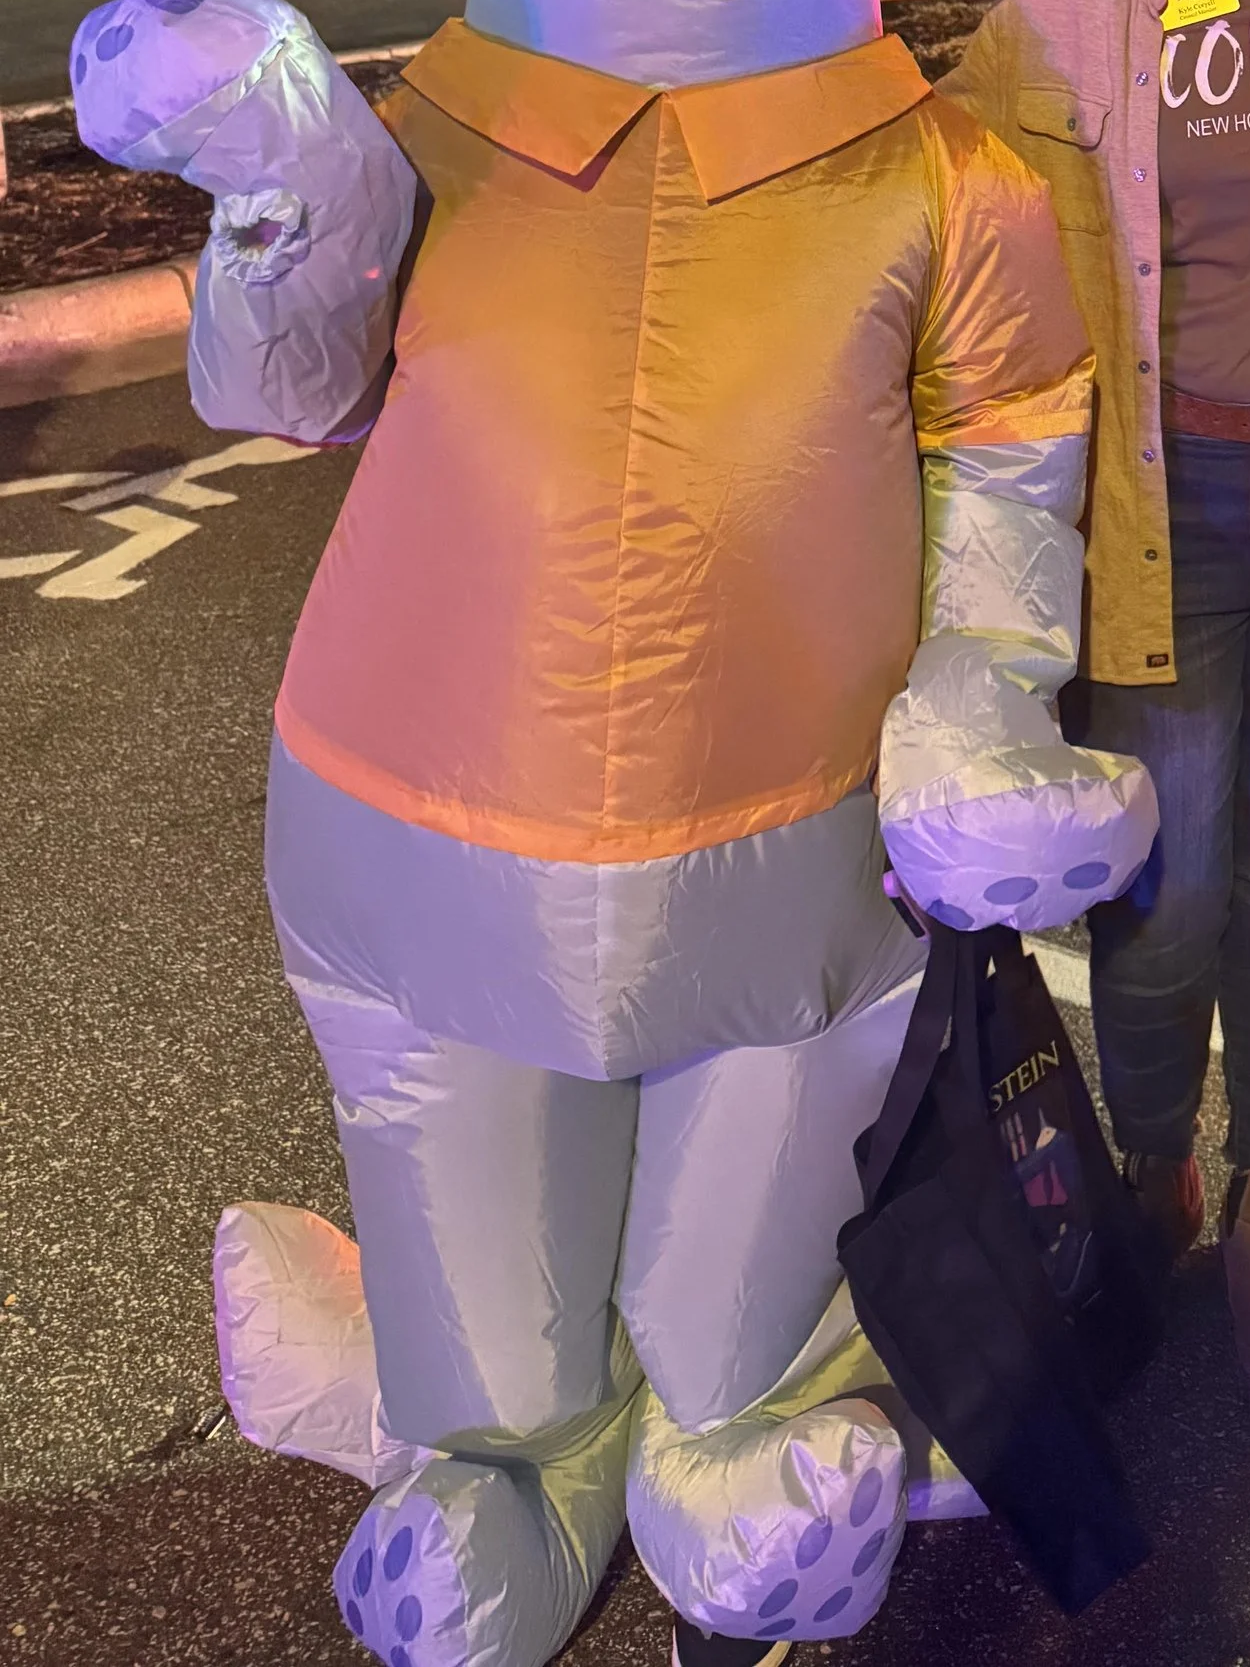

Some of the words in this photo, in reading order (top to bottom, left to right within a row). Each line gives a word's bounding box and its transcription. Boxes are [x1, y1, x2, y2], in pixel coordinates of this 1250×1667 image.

[1178, 5, 1193, 15] Kyle
[1186, 116, 1230, 138] NEW
[989, 1040, 1060, 1111] STEIN
